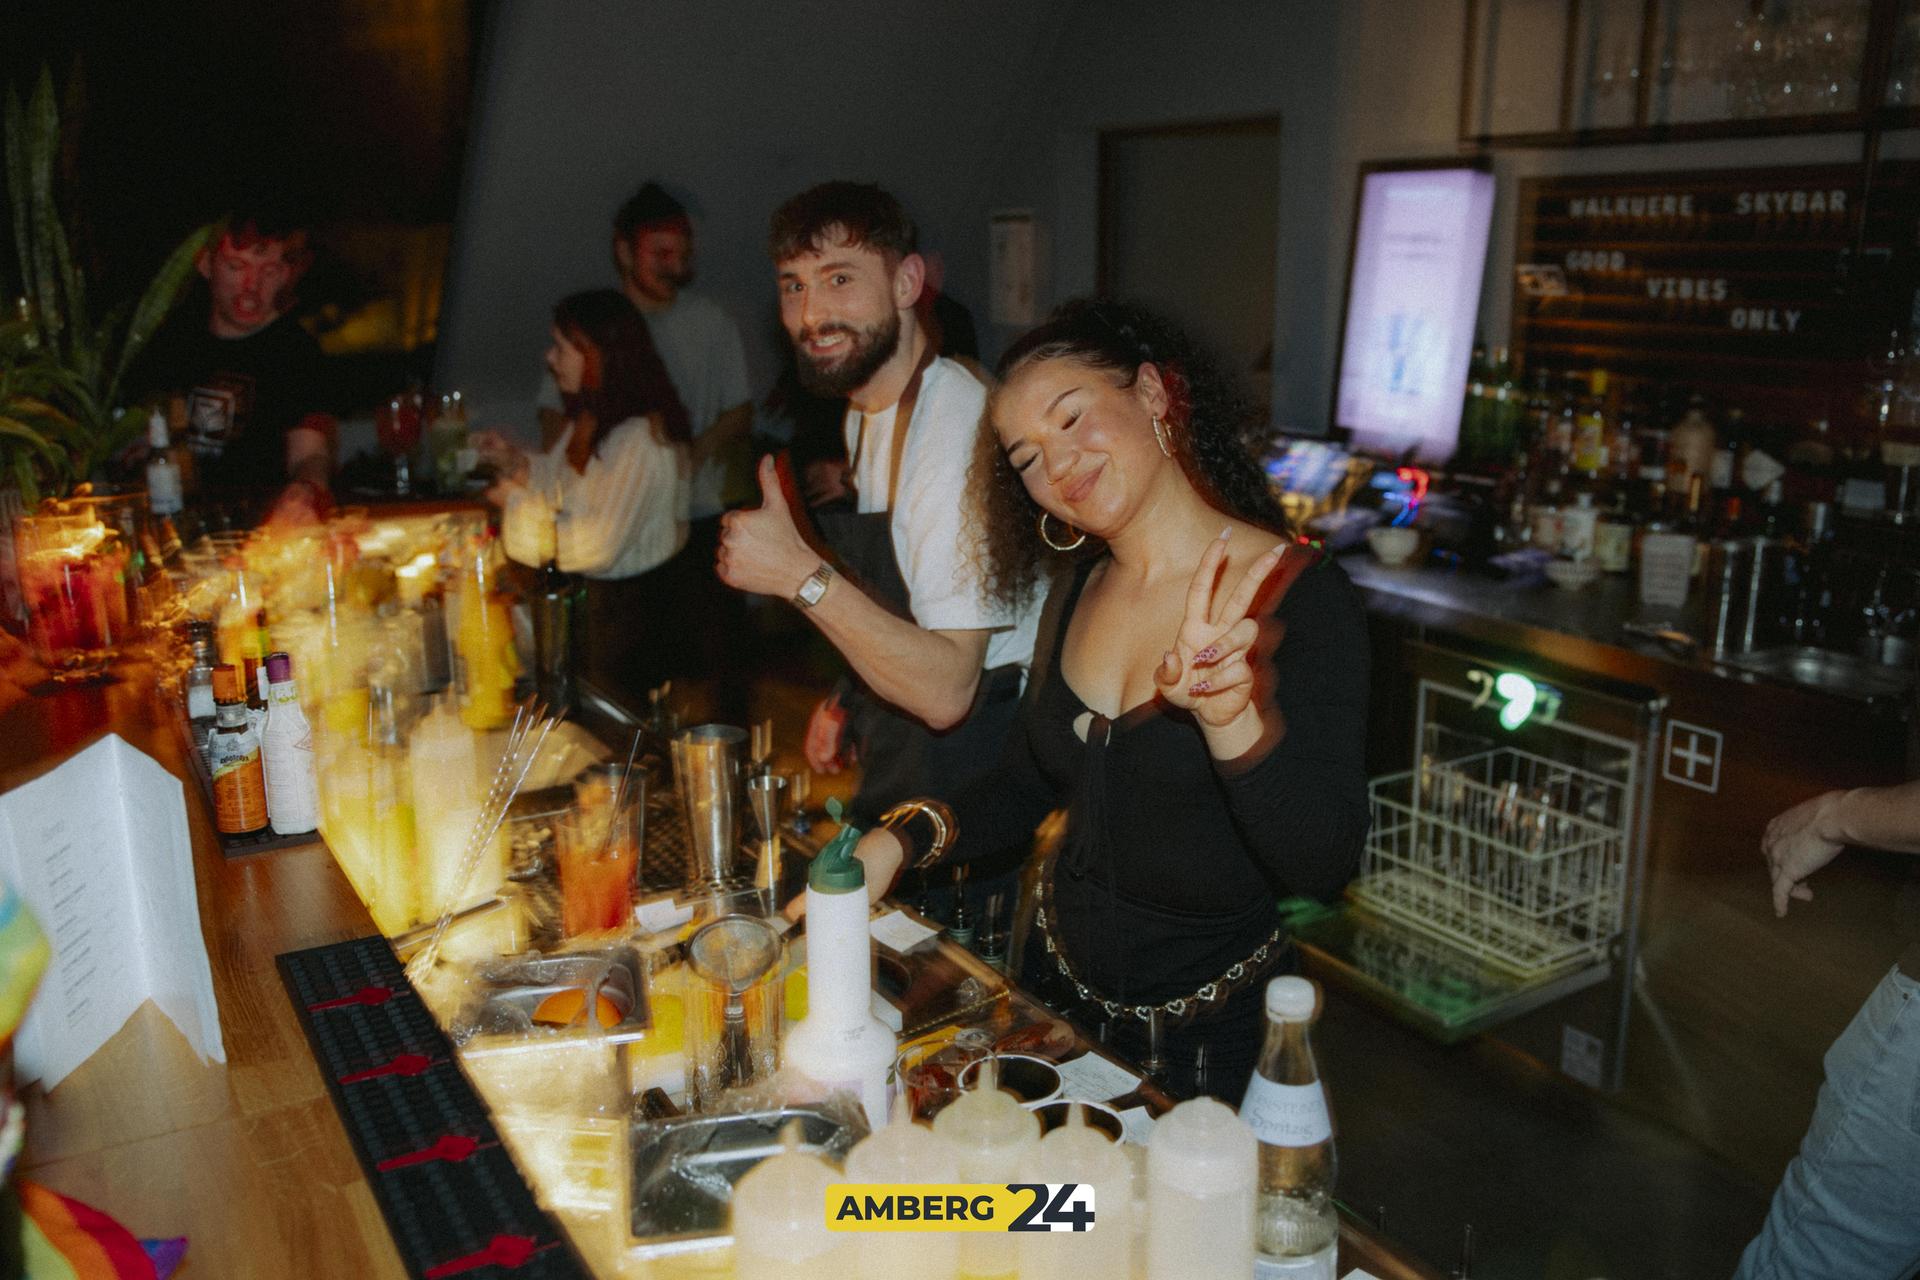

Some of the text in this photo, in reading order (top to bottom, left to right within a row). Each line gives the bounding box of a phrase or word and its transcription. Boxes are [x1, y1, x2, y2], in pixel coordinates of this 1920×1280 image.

[1736, 189, 1848, 215] SKYBAR
[1566, 249, 1625, 272] GOOD
[1646, 277, 1728, 302] VIBES
[1730, 306, 1801, 333] ONLY
